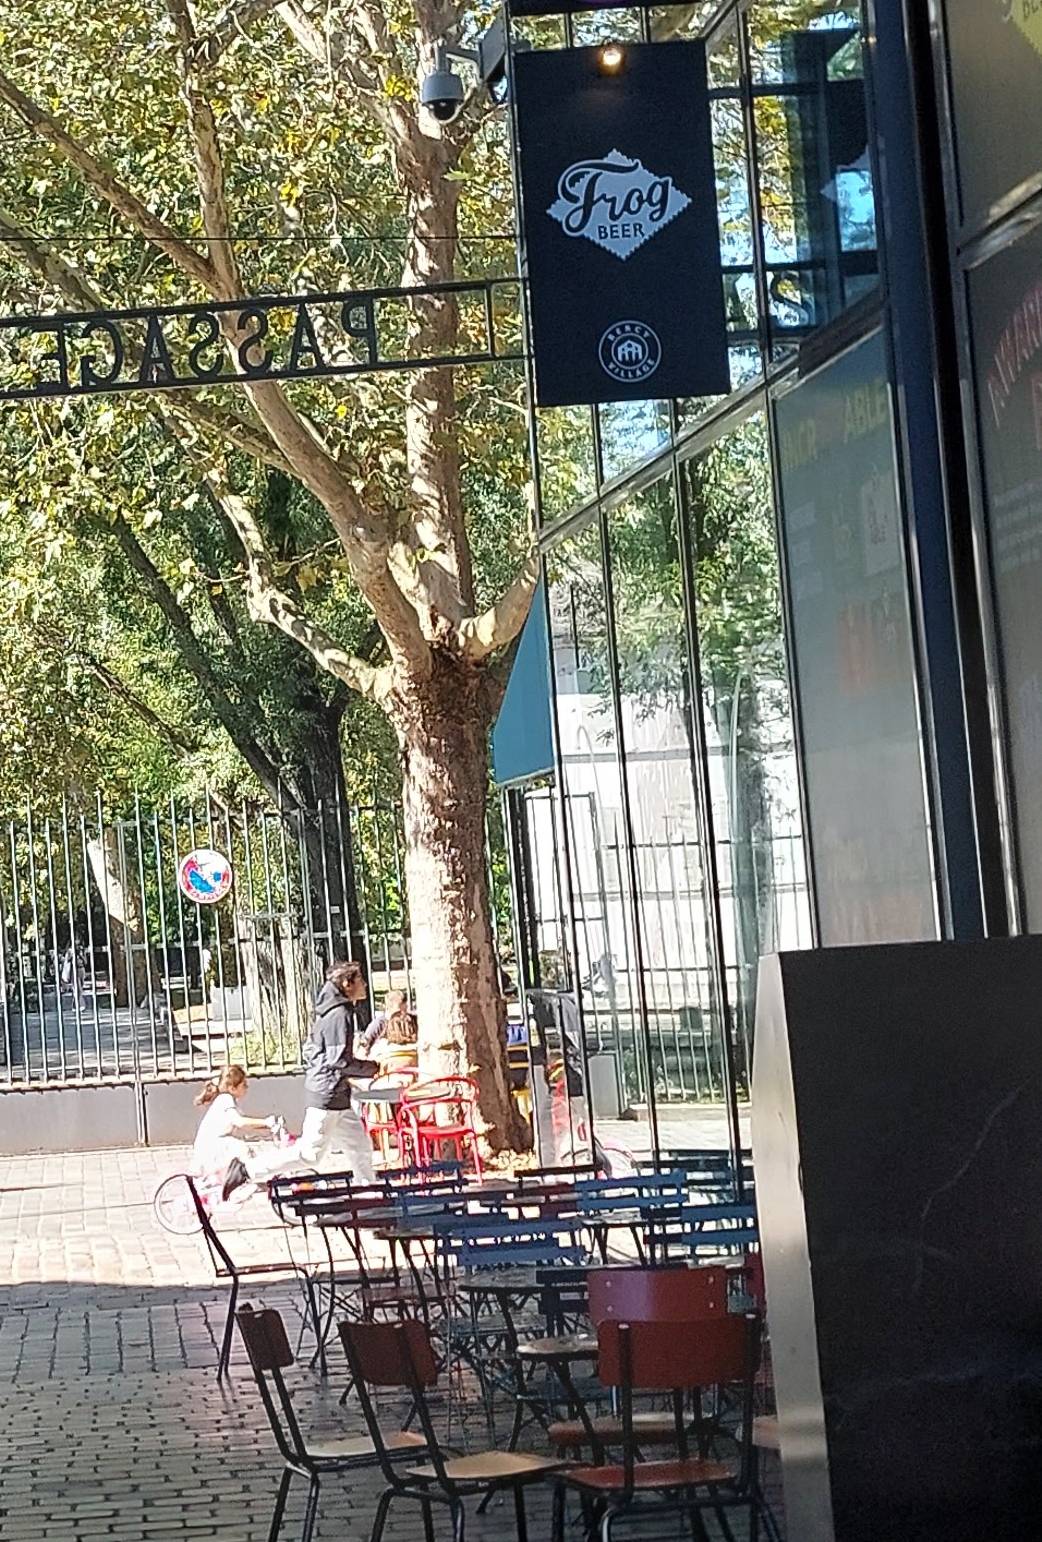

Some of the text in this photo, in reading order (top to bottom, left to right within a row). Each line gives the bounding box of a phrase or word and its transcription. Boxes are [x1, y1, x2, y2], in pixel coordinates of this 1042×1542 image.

[560, 160, 671, 234] Frog
[597, 222, 645, 241] BEER
[607, 324, 651, 342] BERCY
[608, 359, 655, 379] VILLAGE
